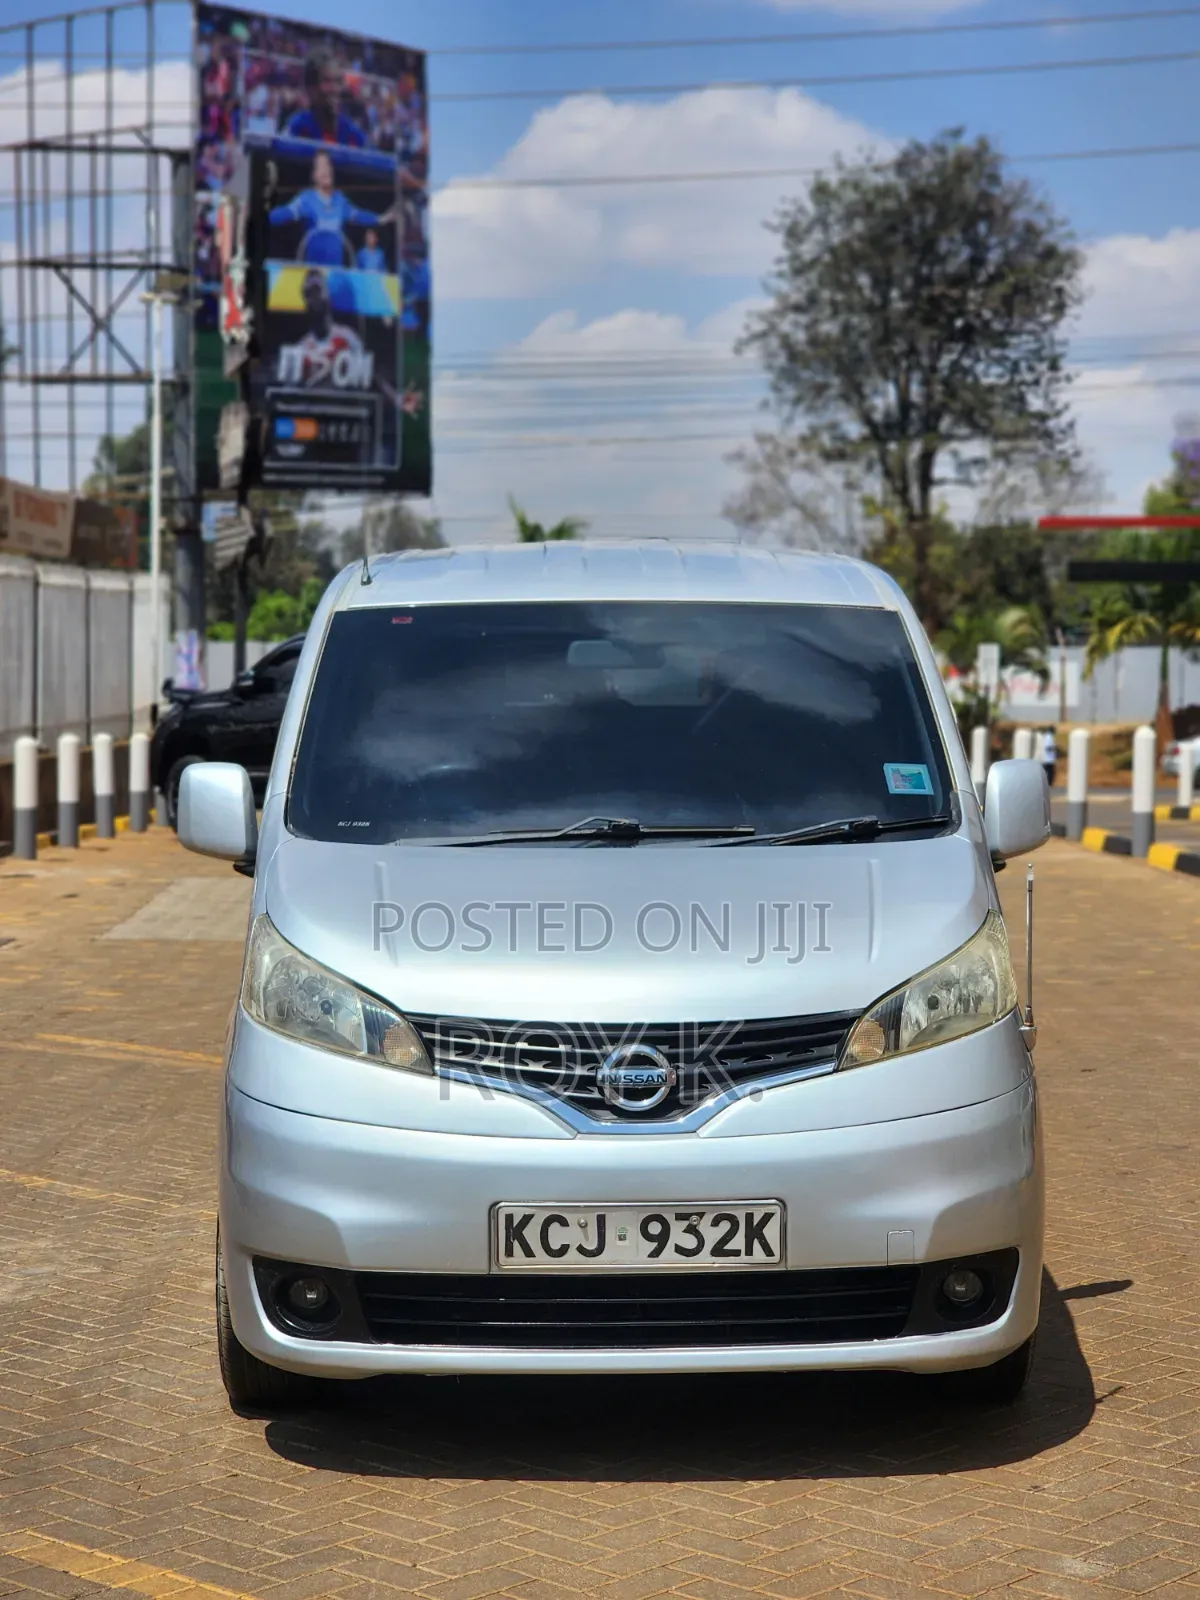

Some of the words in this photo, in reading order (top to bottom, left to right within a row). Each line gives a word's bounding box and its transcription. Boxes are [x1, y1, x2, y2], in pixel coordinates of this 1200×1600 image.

[604, 1073, 668, 1085] NISSAN
[504, 1212, 607, 1259] KCJ
[639, 1211, 776, 1259] 932K
